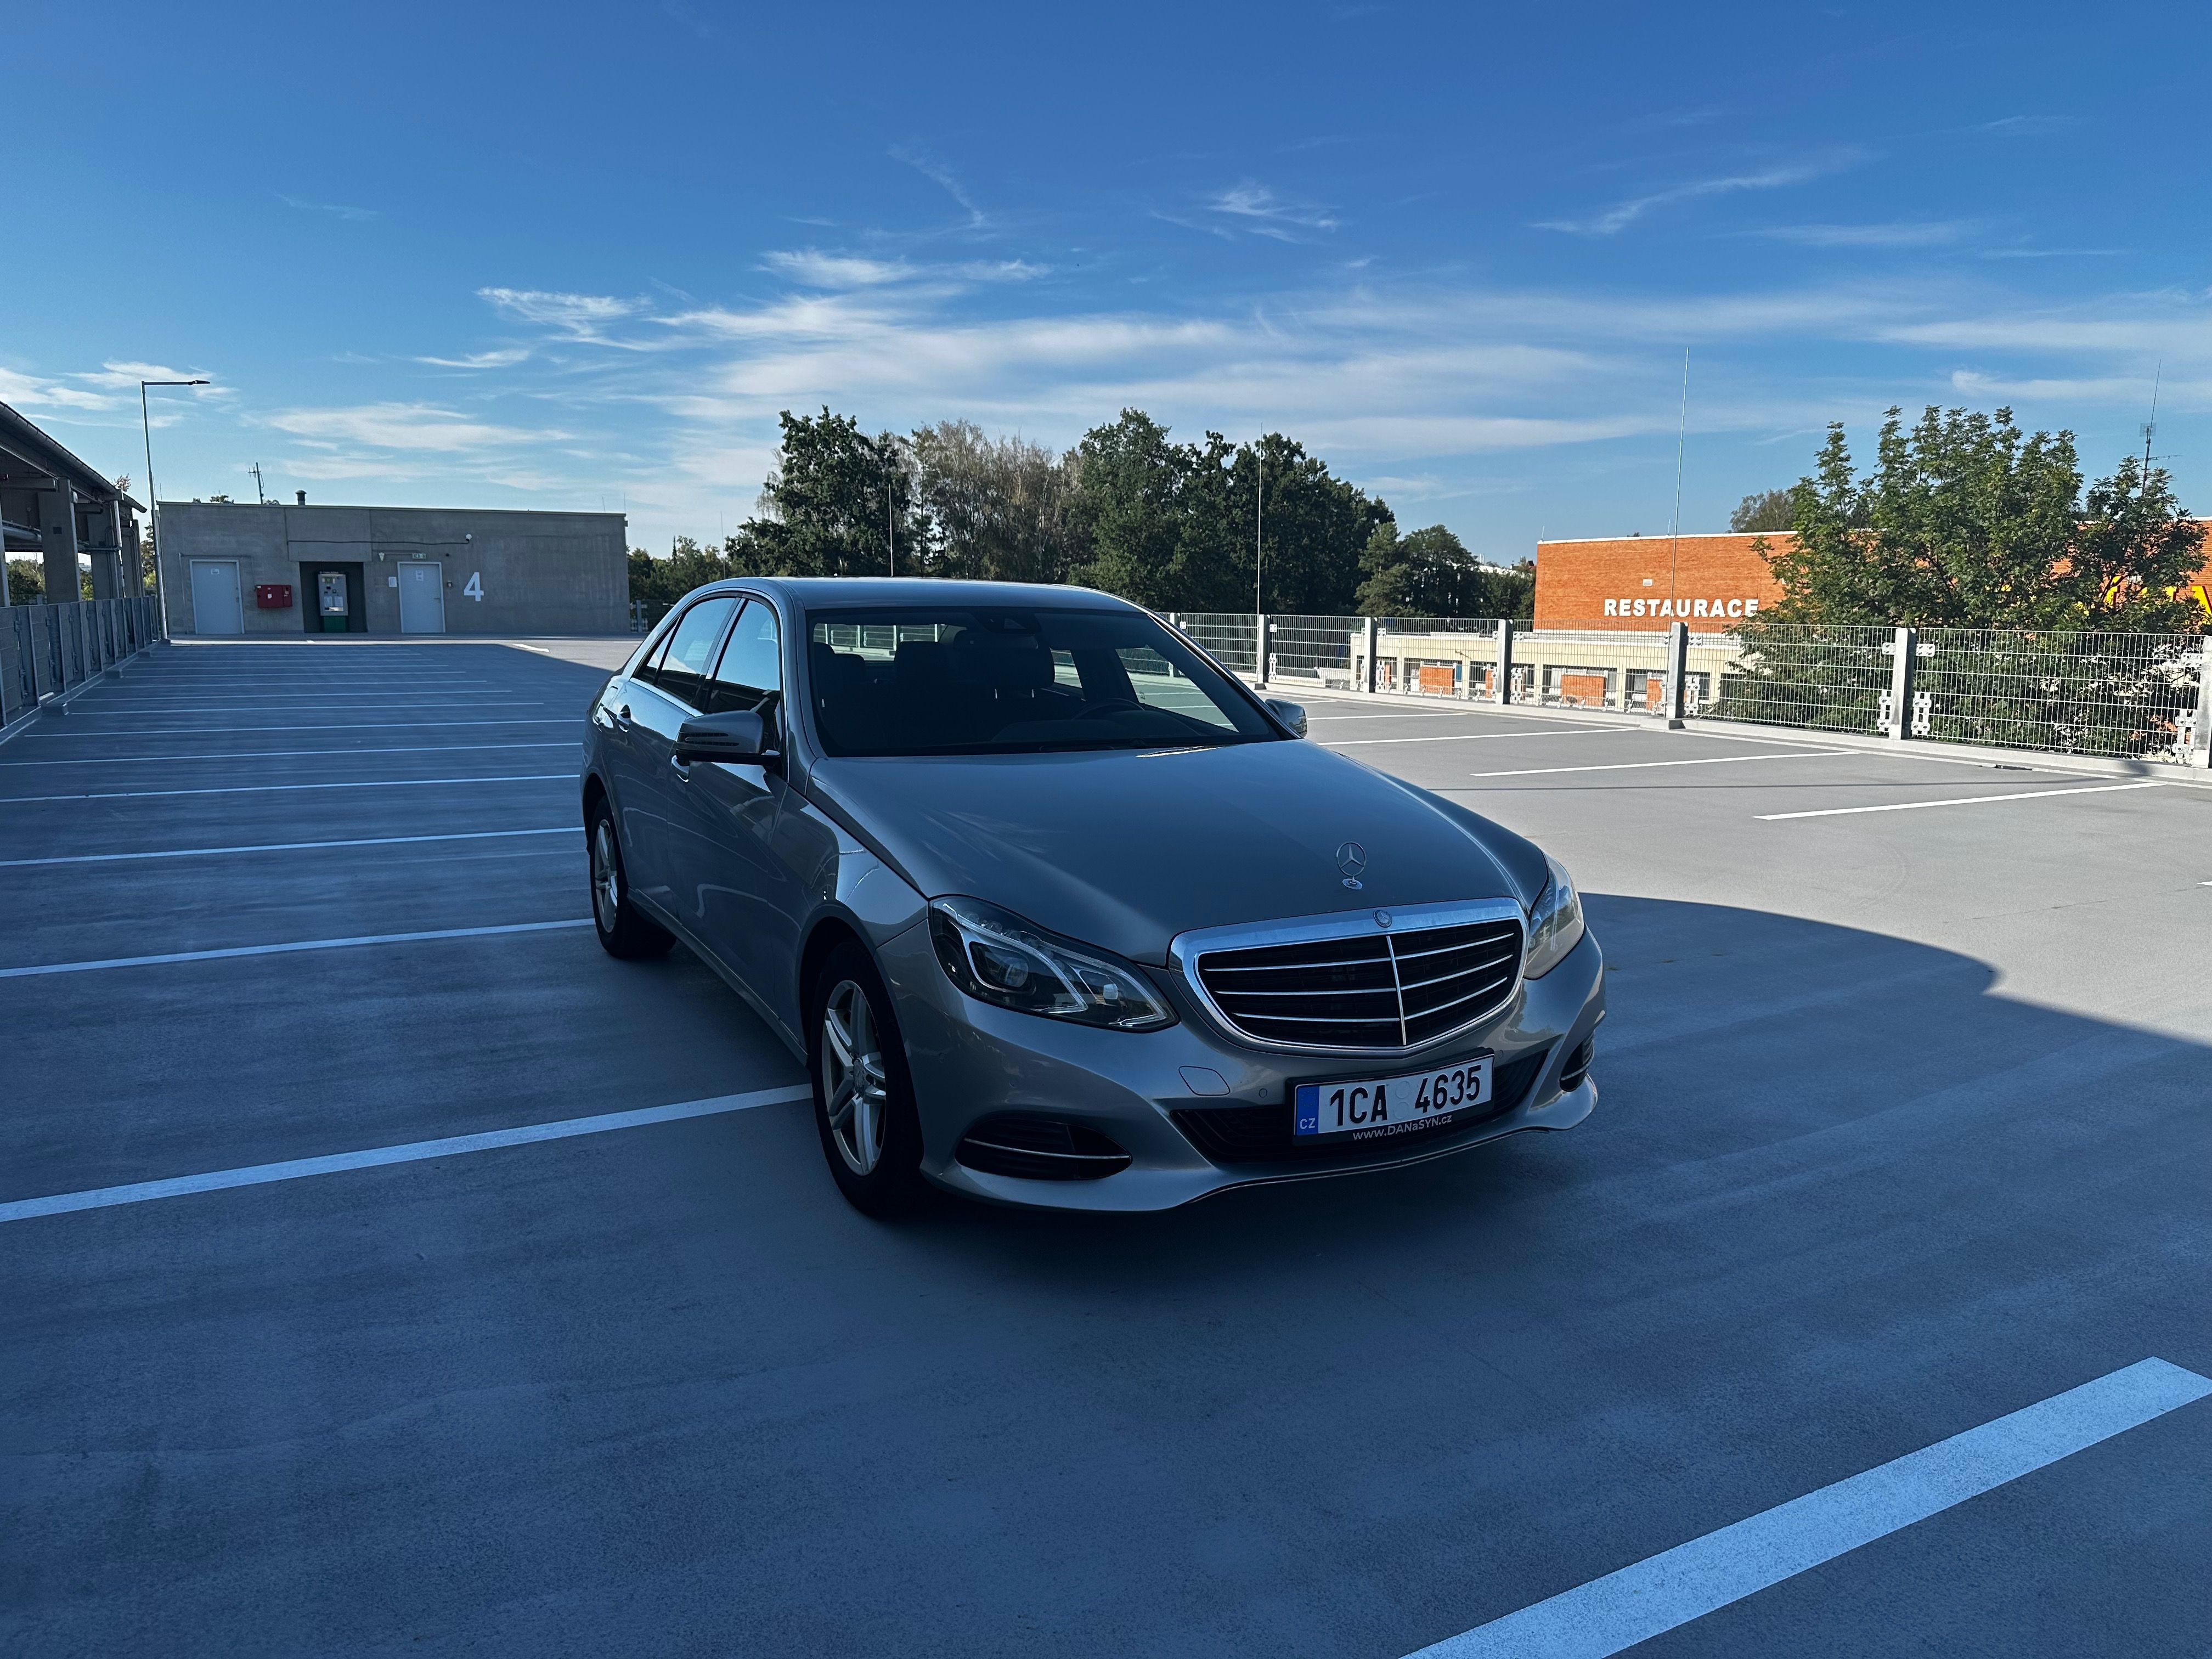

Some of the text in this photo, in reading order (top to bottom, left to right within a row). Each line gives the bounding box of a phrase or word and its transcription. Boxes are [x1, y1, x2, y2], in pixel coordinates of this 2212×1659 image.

[464, 572, 484, 602] 4
[1604, 599, 1759, 617] RESTAURACE
[1330, 1064, 1481, 1126] 1CA 4635
[1300, 1118, 1316, 1130] CZ
